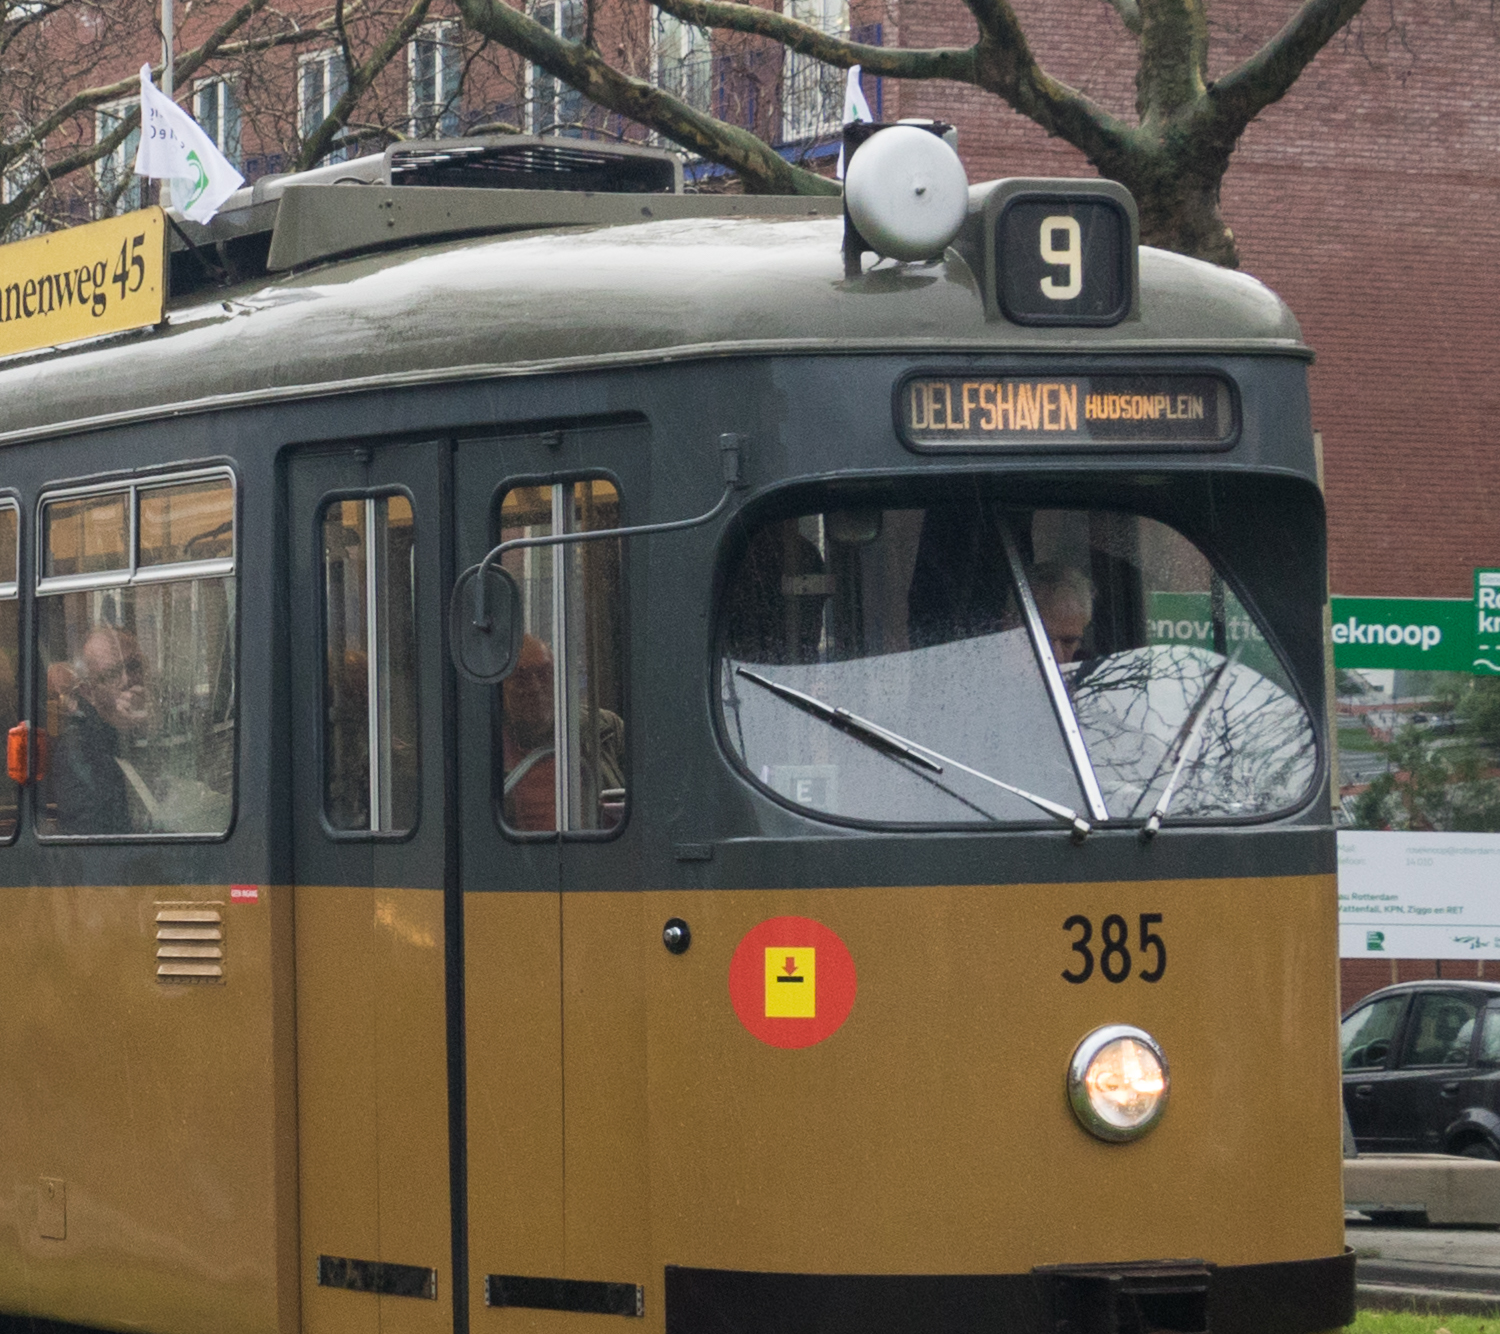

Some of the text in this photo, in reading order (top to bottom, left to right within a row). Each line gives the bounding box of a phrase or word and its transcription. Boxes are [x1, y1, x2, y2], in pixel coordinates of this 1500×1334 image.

[112, 231, 146, 300] 45
[1040, 216, 1082, 300] 9
[910, 382, 1204, 431] DELFSHAVEN HUDSONPLEIN
[1331, 616, 1442, 651] eknoop
[796, 779, 812, 802] E
[1061, 913, 1167, 984] 385
